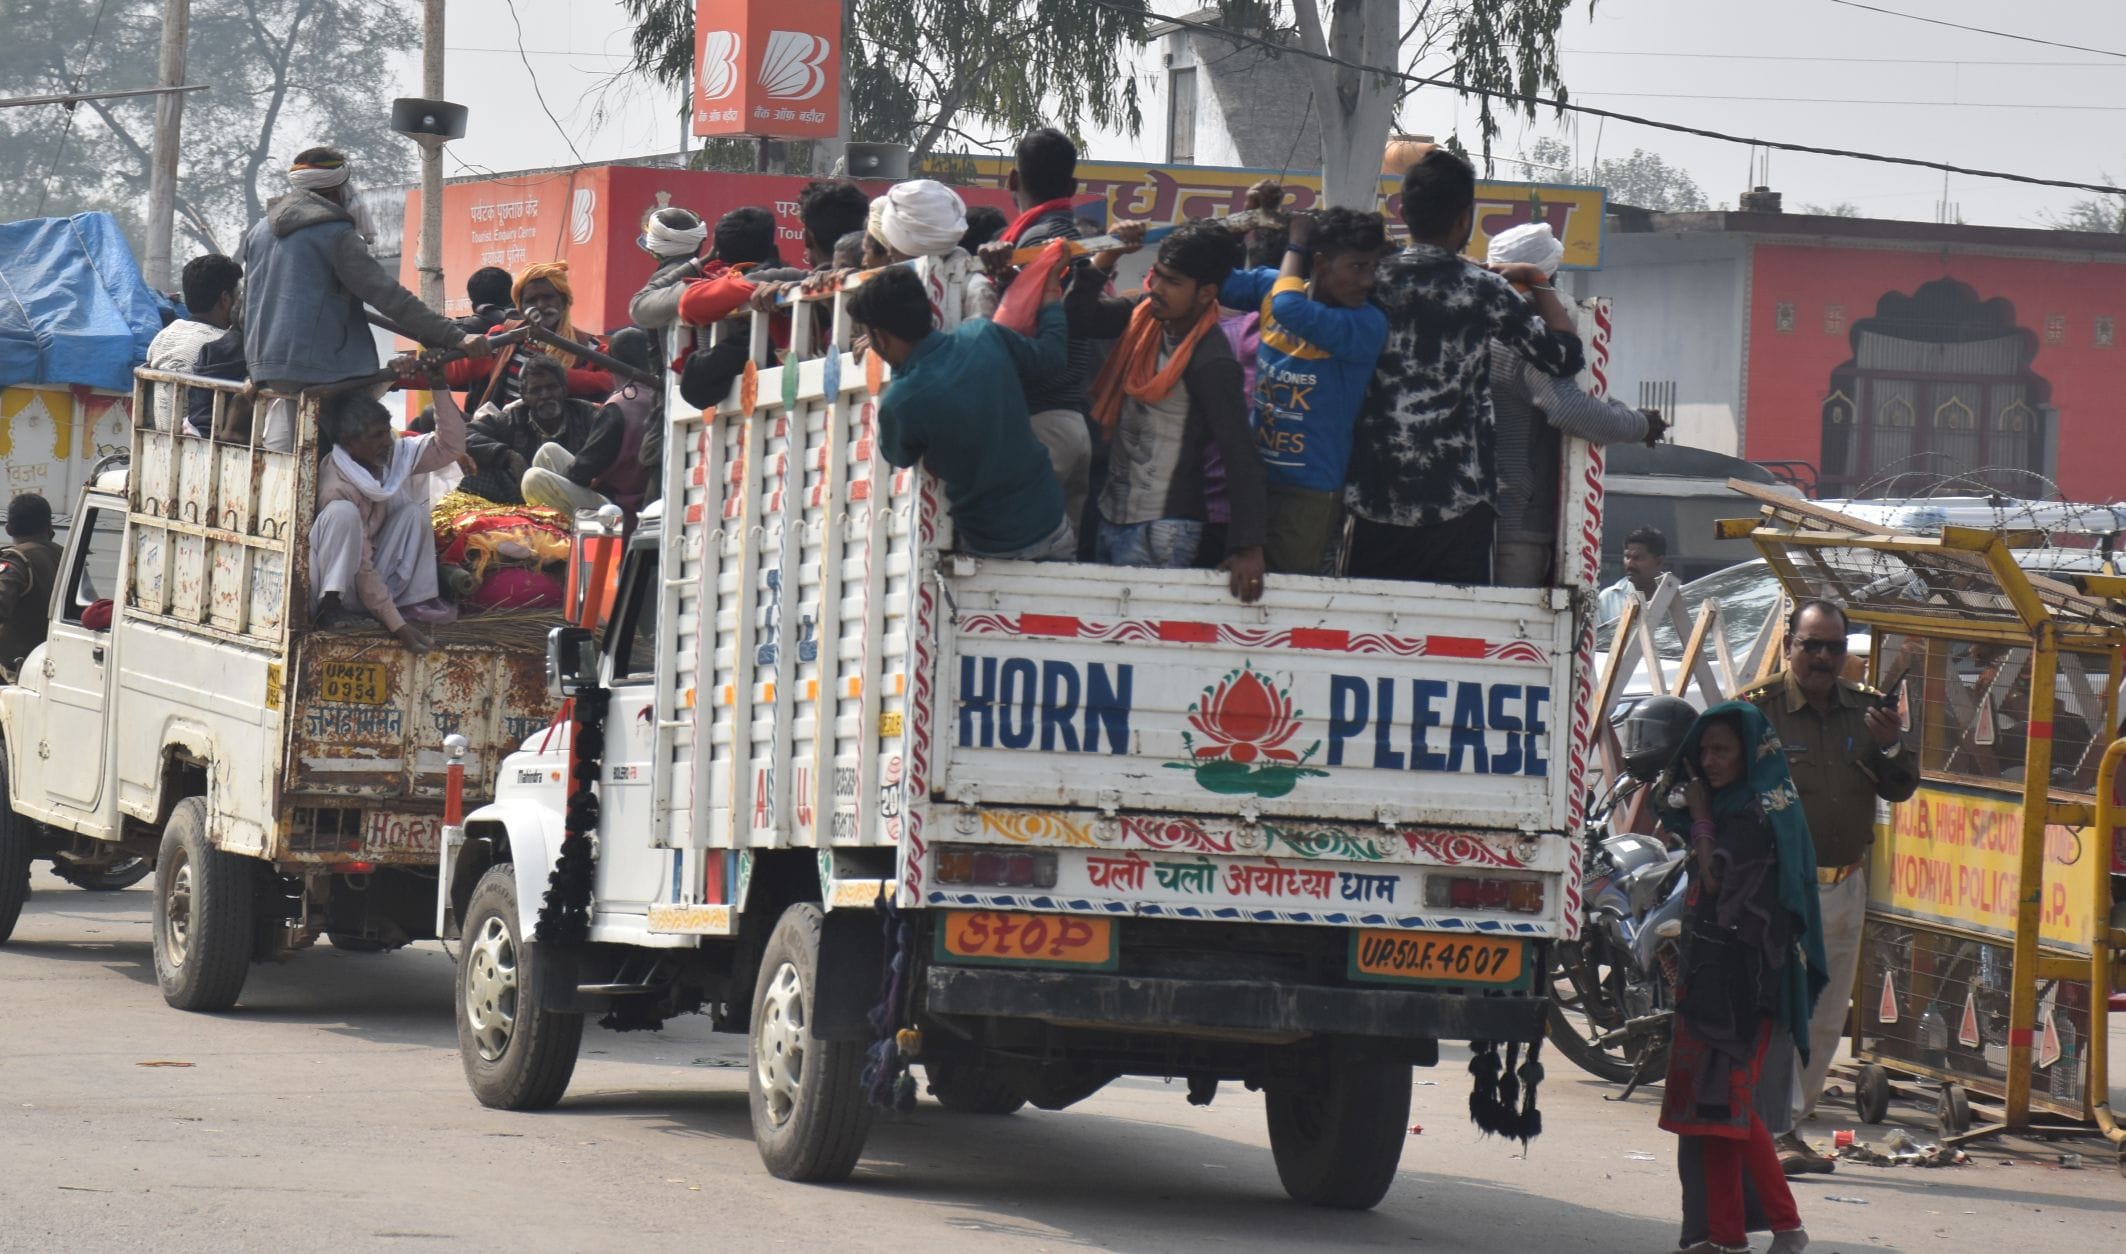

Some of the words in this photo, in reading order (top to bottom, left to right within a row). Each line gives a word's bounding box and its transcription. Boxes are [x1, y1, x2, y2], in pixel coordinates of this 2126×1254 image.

[1276, 369, 1318, 386] JONES
[327, 681, 377, 700] 0954
[960, 655, 1133, 756] HORN
[1327, 673, 1550, 777] PLEASE
[1936, 802, 1966, 846] HIGH
[1971, 808, 2020, 857] SECURI
[1087, 851, 1150, 893] चलो
[1154, 855, 1218, 895] चलो
[1223, 857, 1336, 899] अयोध्या
[1339, 871, 1401, 904] धाम
[1890, 851, 1952, 906] AYODHYA
[1958, 864, 2018, 917] POLICE
